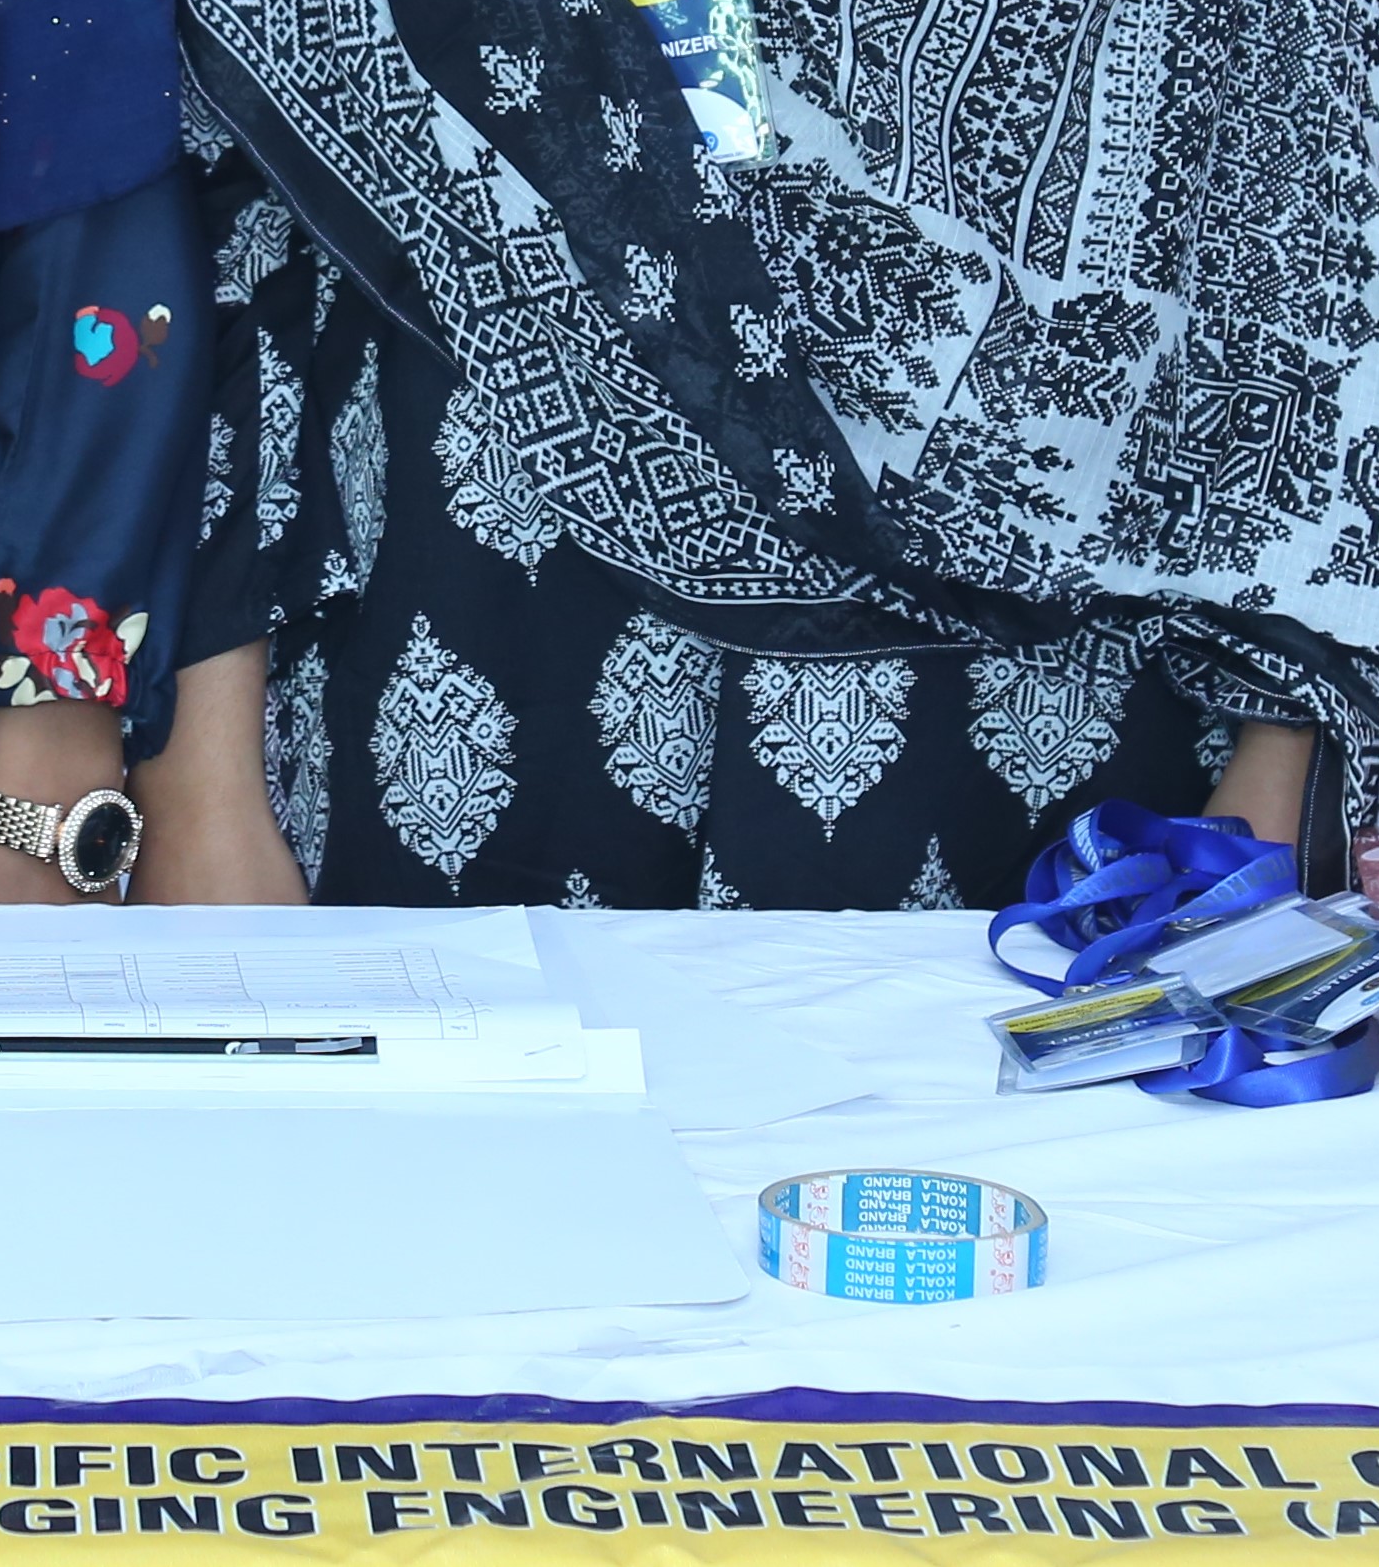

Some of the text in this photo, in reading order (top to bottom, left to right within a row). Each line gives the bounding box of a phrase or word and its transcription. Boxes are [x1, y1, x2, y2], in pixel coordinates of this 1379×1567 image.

[862, 1176, 968, 1195] KOALA BRAND
[921, 1193, 968, 1208] KOALA
[921, 1205, 968, 1221] KOALA
[858, 1211, 967, 1234] KOALA BRAND
[845, 1247, 957, 1261] KOALA BRAND
[845, 1260, 957, 1275] KOALA BRAND
[845, 1272, 956, 1288] KOALA BRAND
[844, 1285, 956, 1302] KOALA BRAND
[291, 1436, 1320, 1492] INTERNATIONAL
[369, 1484, 1247, 1541] ENGINEERING
